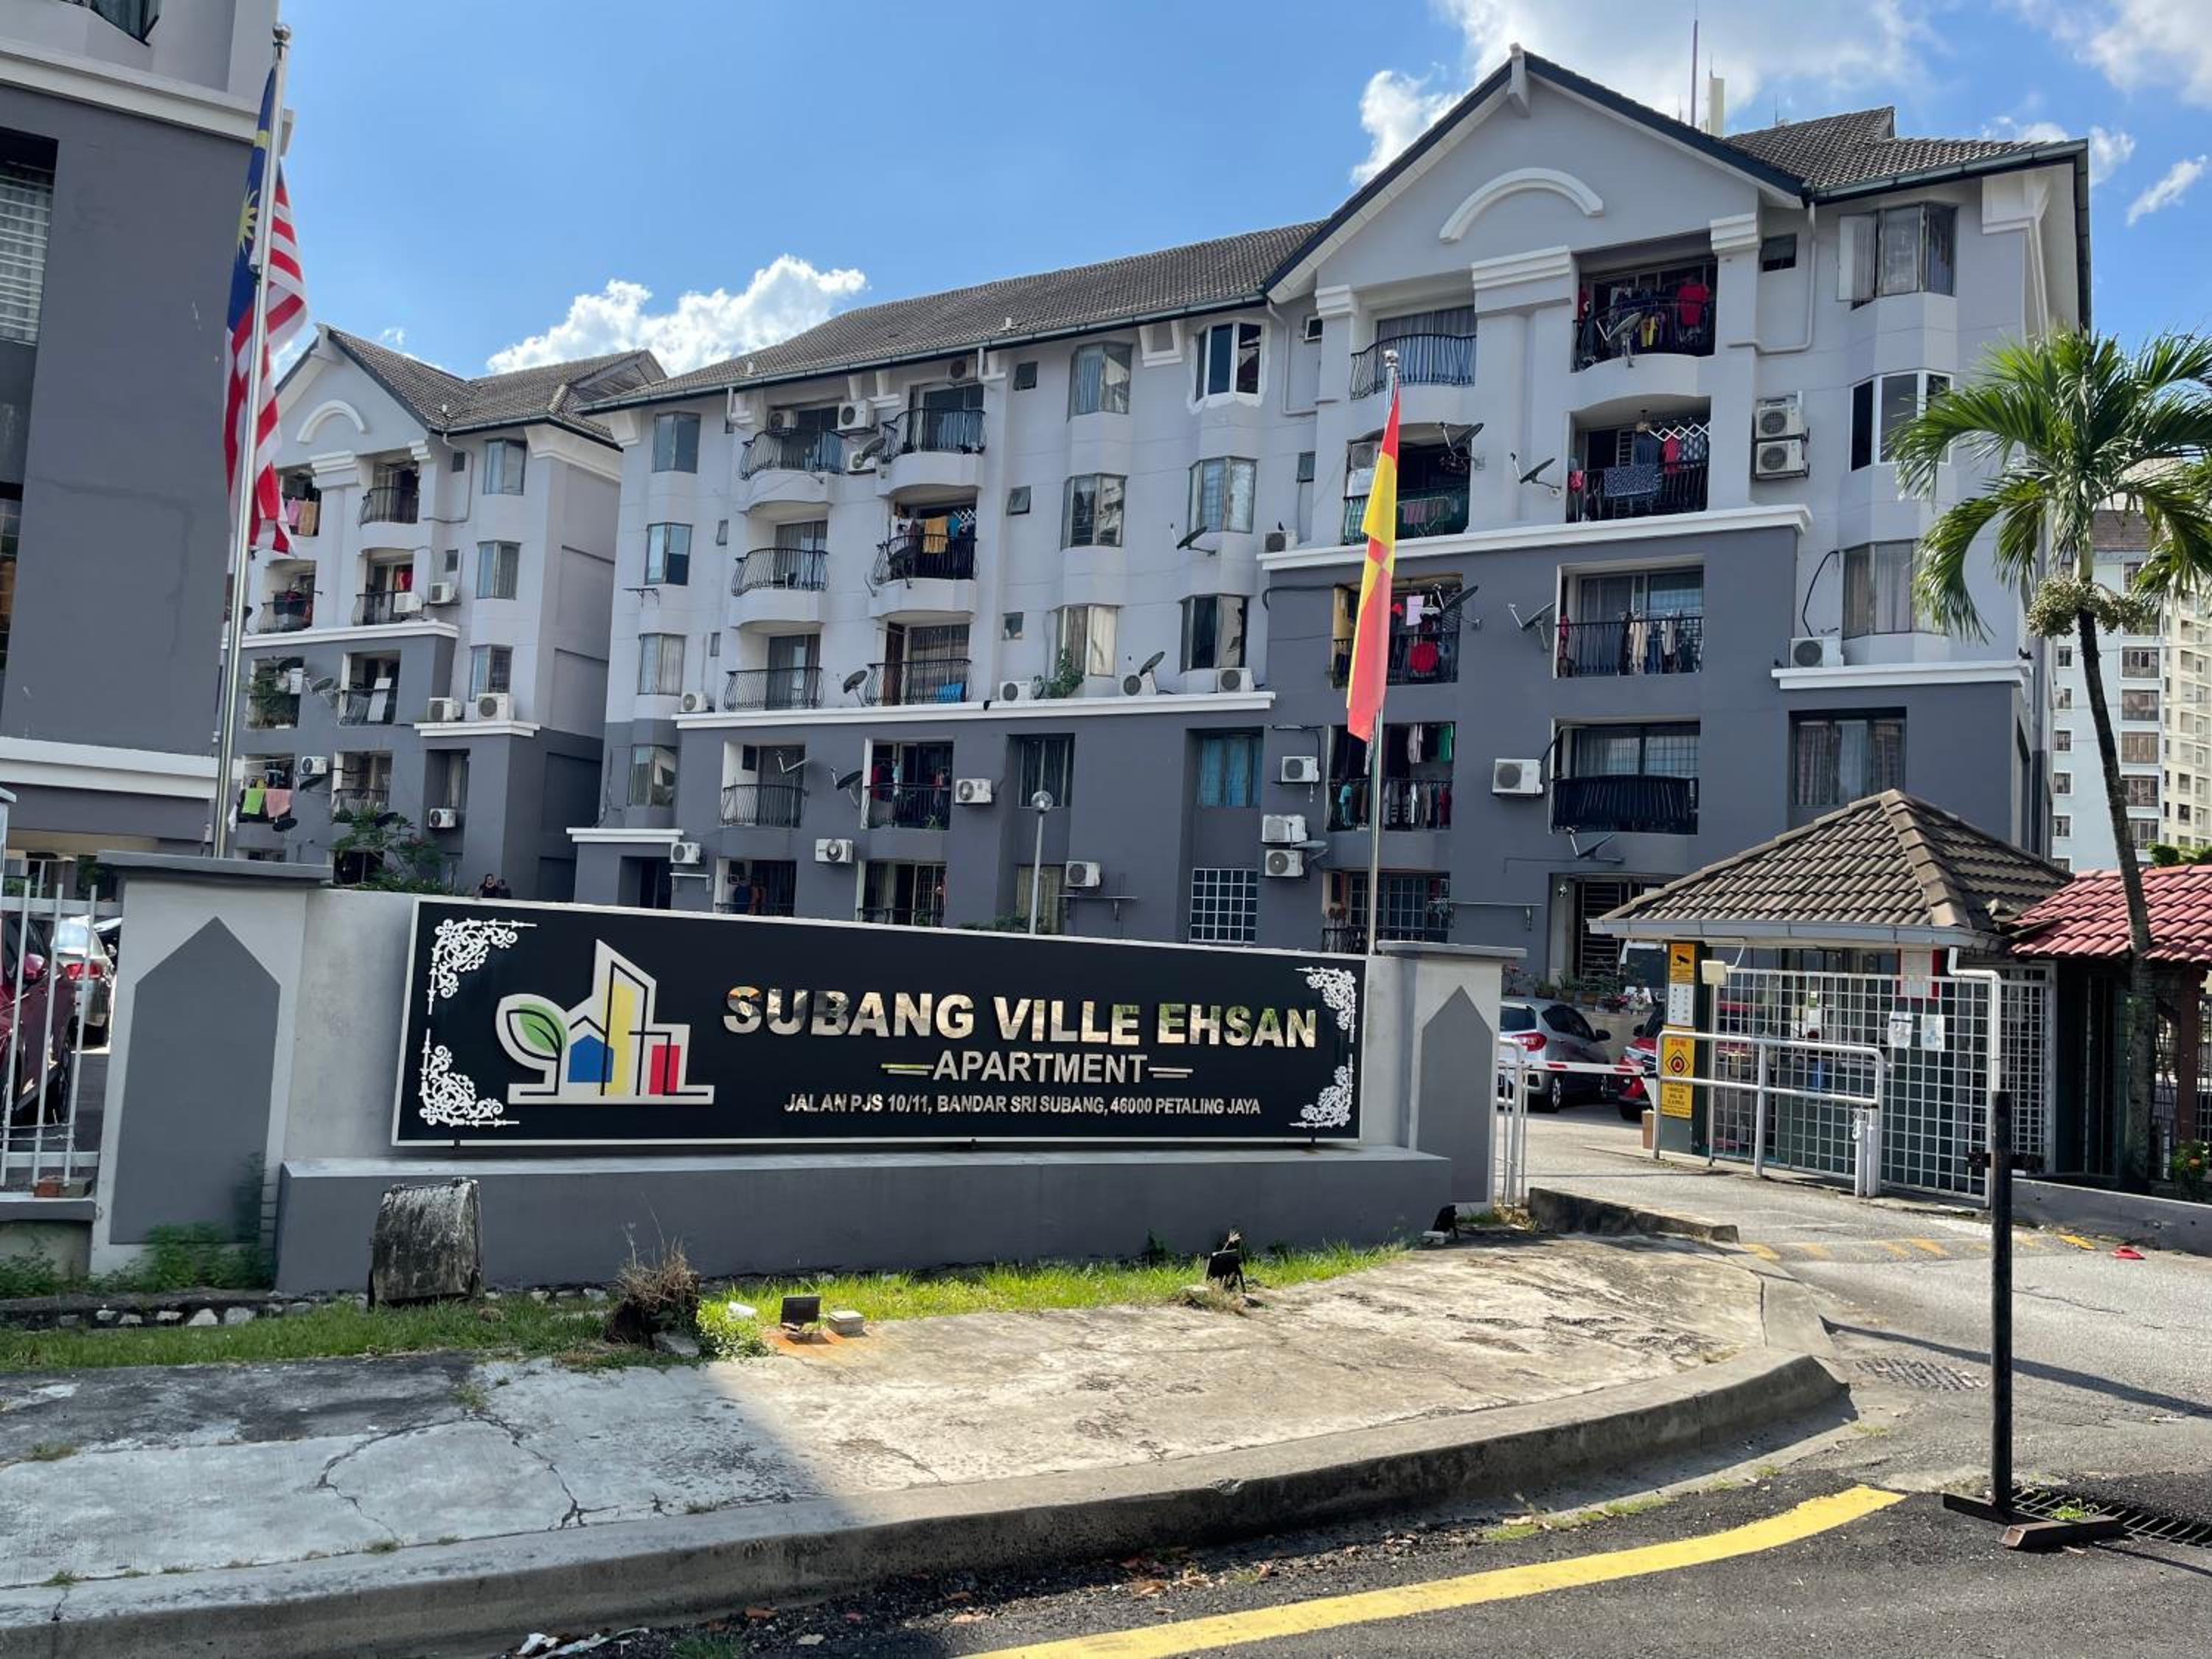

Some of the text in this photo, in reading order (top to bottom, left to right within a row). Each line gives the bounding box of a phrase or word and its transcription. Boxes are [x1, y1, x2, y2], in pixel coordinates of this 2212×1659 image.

[723, 986, 1317, 1048] SUBANG VILLE EHSAN
[933, 1049, 1148, 1085] APARTMENT
[784, 1093, 1262, 1116] JALAN PJS 10/11, BANDAR SRI SUBANG, 46000 PETALING JAYA
